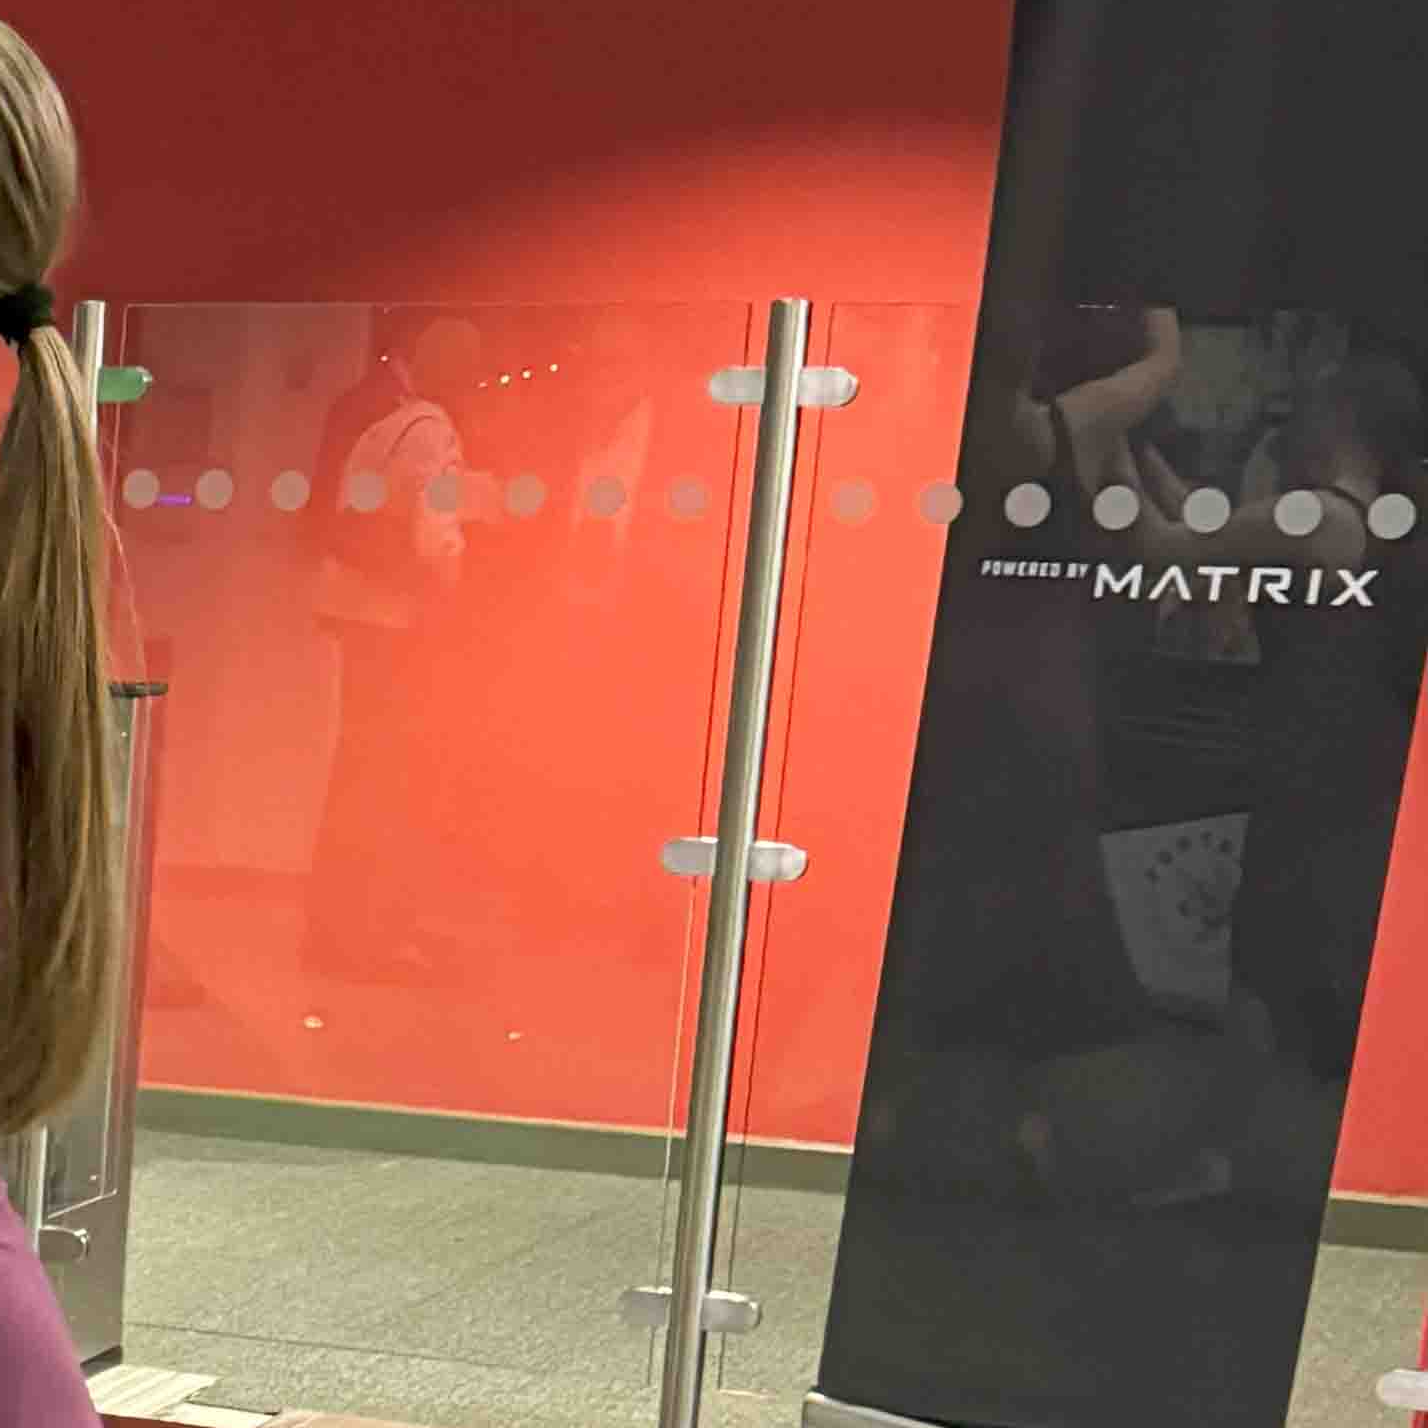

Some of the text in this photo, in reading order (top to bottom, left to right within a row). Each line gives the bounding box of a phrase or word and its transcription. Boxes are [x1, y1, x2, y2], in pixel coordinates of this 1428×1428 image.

[981, 559, 1378, 606] POWERED BY MATRIX
